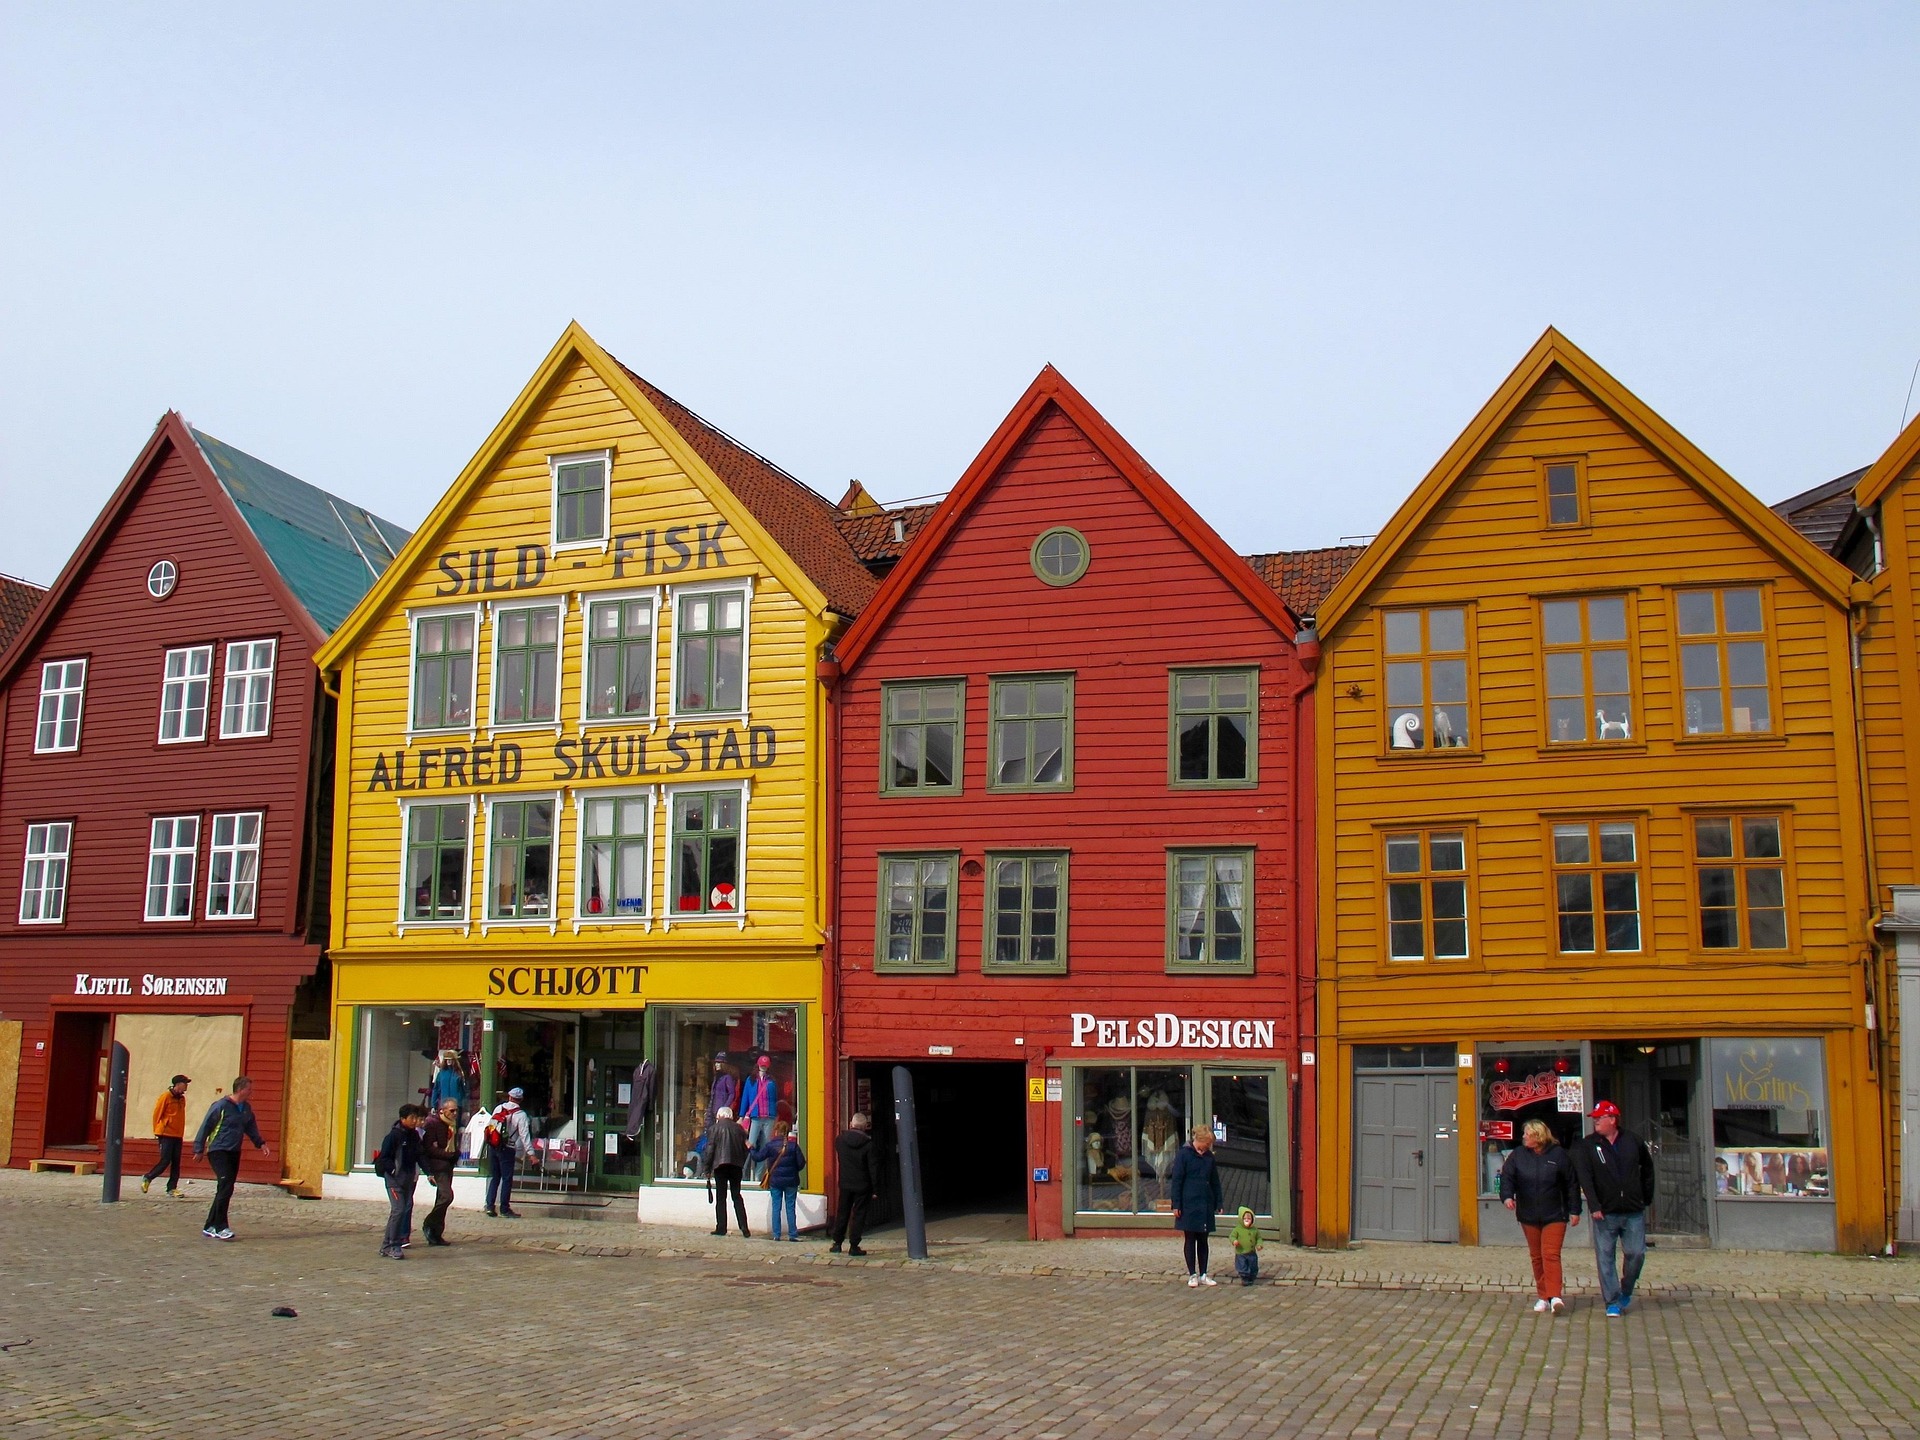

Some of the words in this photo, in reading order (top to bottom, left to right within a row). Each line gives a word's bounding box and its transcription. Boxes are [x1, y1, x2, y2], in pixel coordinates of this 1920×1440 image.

[436, 544, 546, 597] SILD
[612, 520, 729, 579] FISK
[367, 743, 523, 792] ALFRED
[553, 725, 777, 780] SKULSTAD
[488, 965, 649, 996] SCHJØTT
